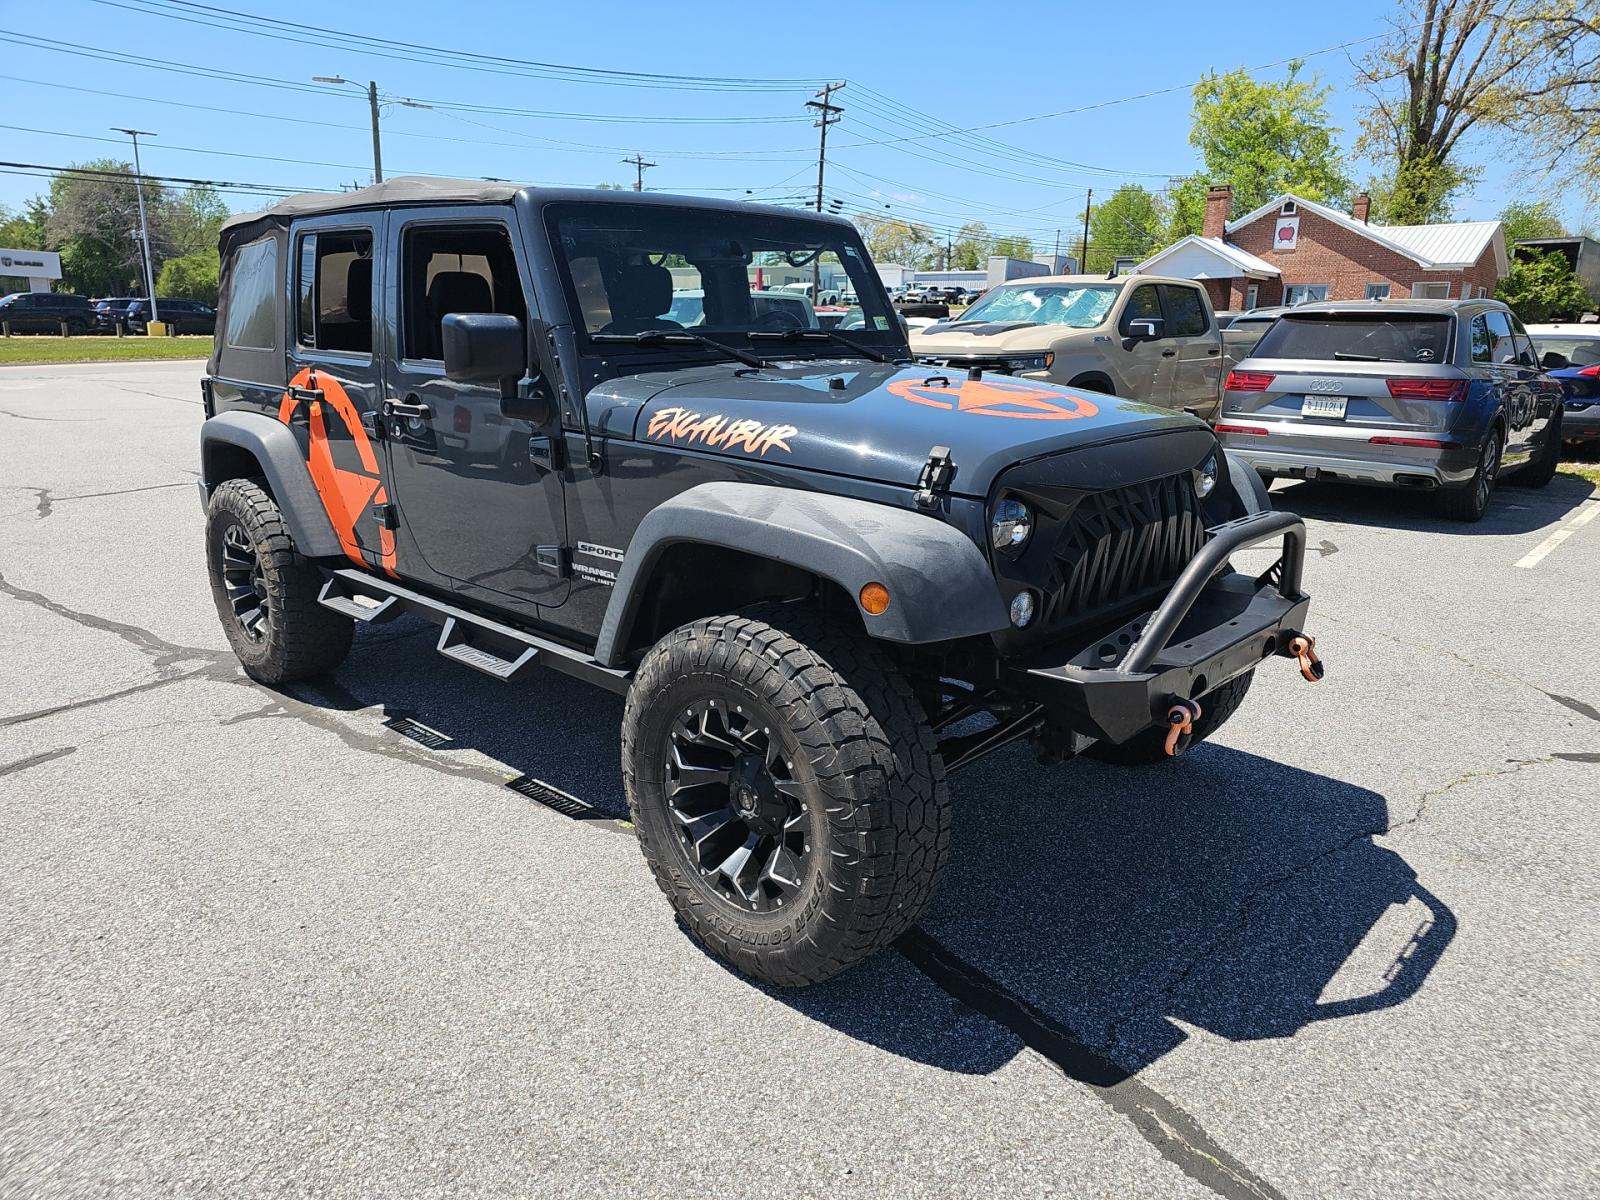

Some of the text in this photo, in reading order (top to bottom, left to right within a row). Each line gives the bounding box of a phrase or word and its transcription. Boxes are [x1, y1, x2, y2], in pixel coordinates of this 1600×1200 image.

[647, 407, 798, 457] EXCALIBUR
[580, 544, 624, 559] SPORT
[571, 562, 617, 580] WRANGL
[581, 574, 615, 587] UNLIMIT
[704, 912, 792, 945] COUNTRY
